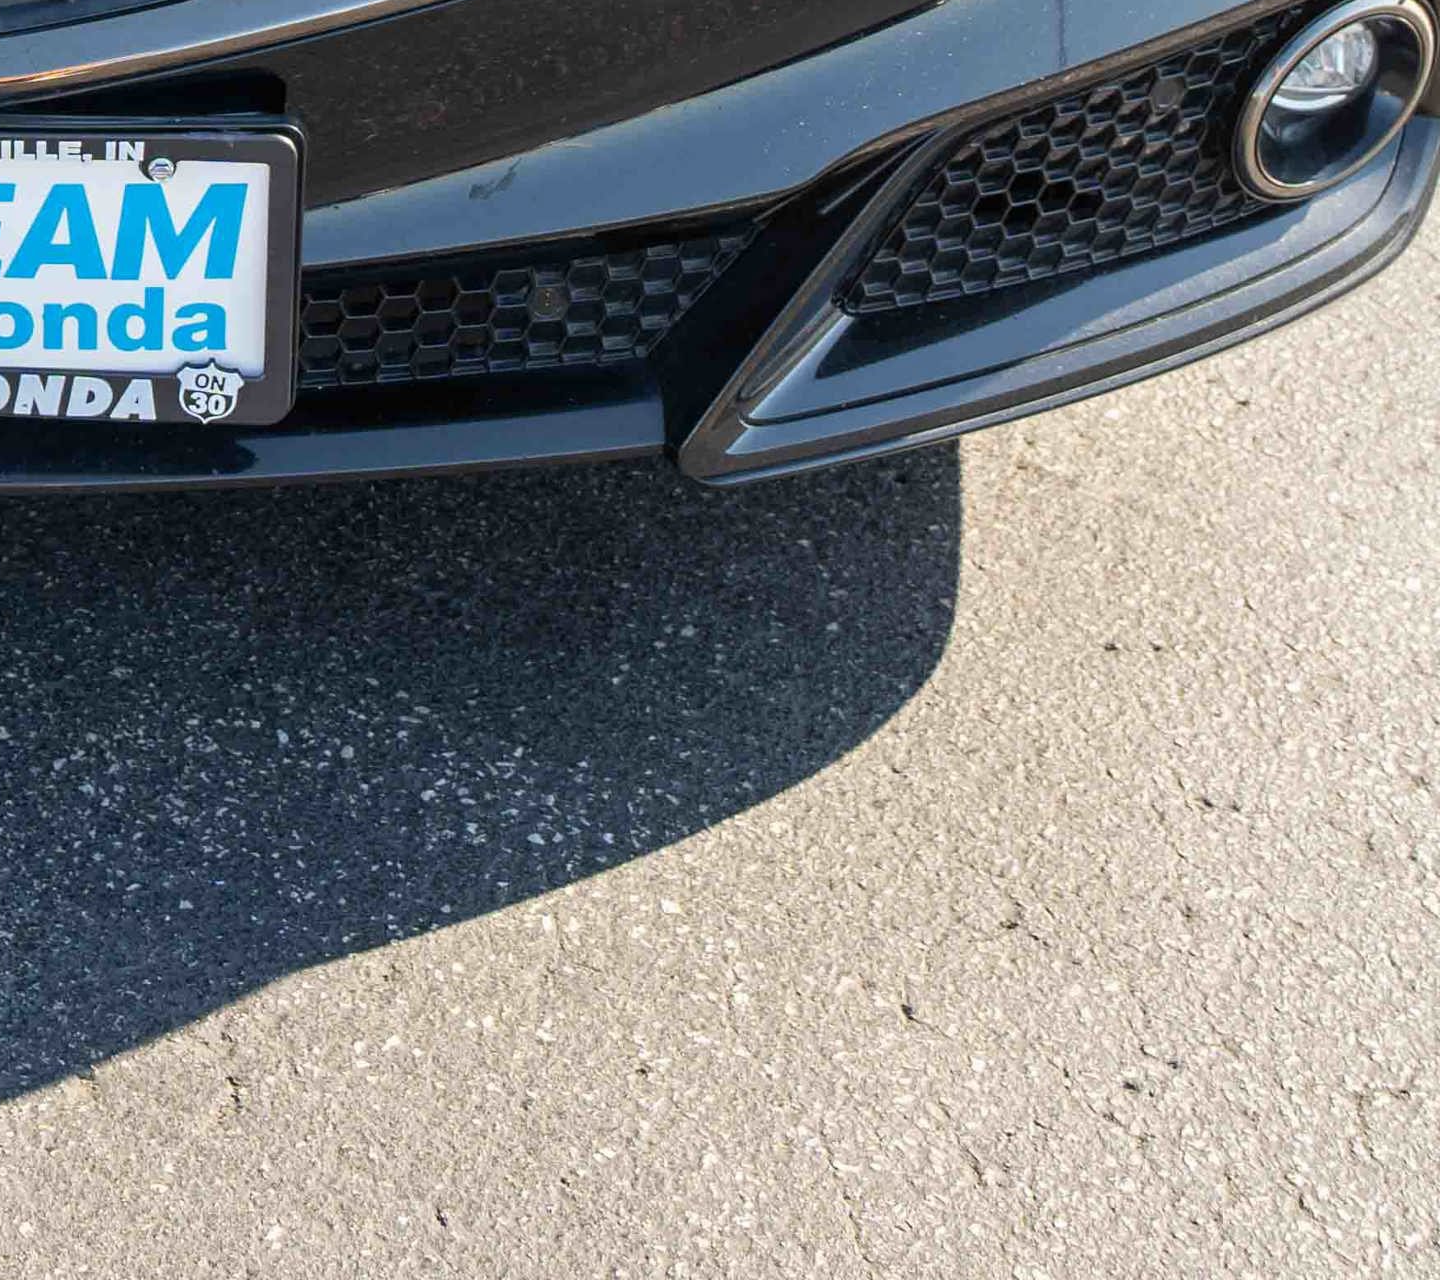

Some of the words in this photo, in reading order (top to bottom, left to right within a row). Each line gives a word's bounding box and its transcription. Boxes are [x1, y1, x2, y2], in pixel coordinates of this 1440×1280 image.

[105, 141, 146, 163] IN
[195, 373, 226, 391] ON
[189, 391, 226, 417] 30
